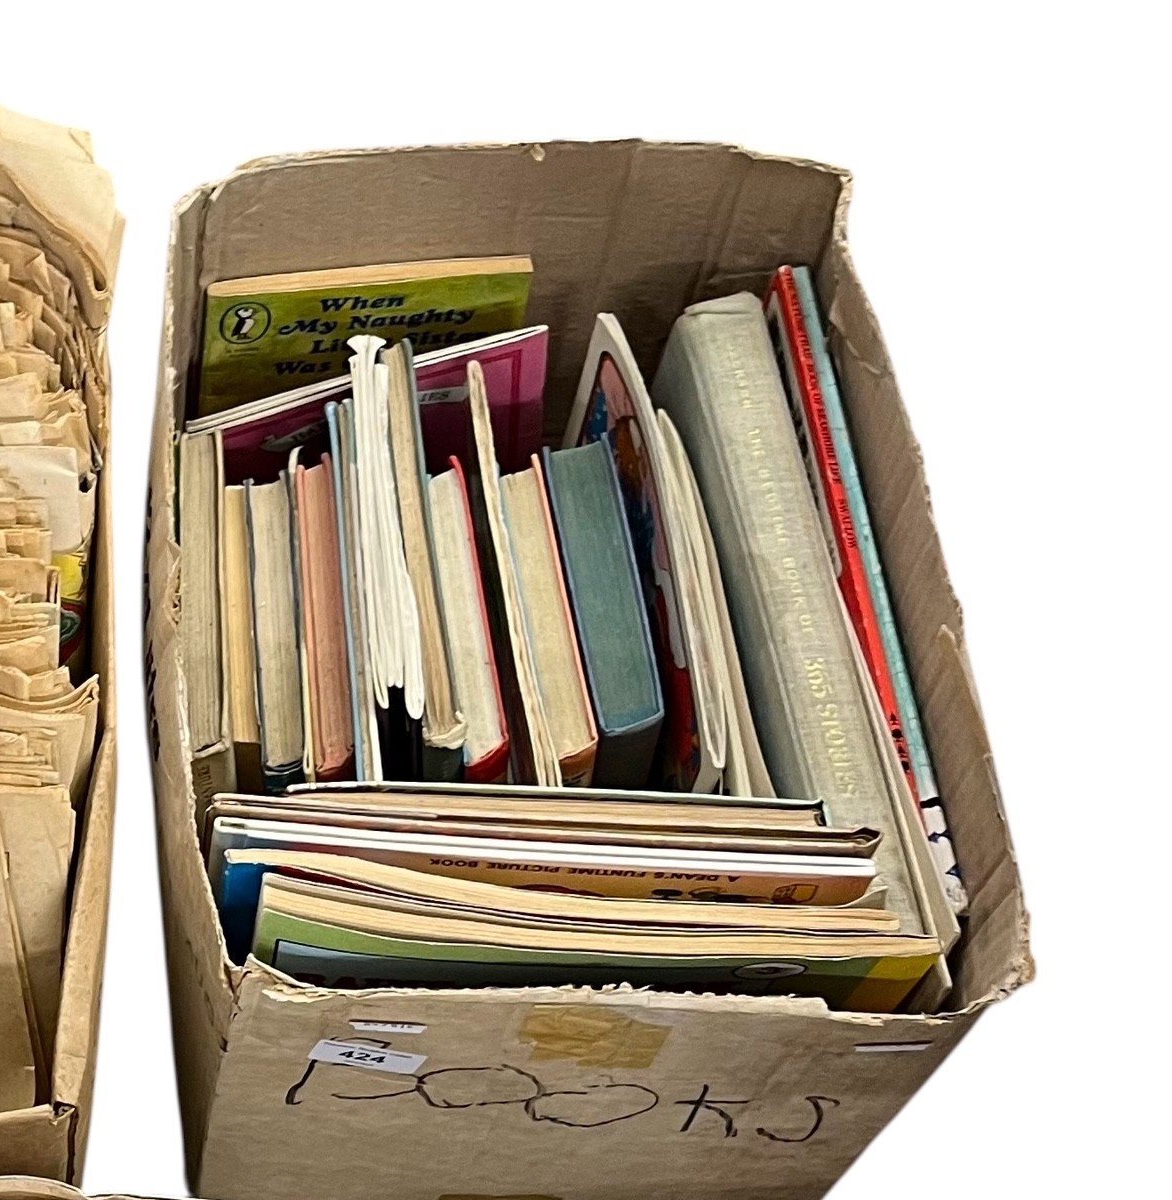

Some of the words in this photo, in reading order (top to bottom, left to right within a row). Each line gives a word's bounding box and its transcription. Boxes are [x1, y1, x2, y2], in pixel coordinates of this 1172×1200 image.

[319, 296, 405, 312] When
[279, 318, 338, 335] My
[347, 308, 476, 329] Naughty
[273, 360, 332, 376] Was
[782, 556, 807, 606] BOOK
[799, 615, 815, 634] OF
[804, 656, 834, 699] 365
[818, 703, 859, 798] STORIES
[428, 857, 479, 869] BOOK
[486, 861, 561, 874] PICTURE
[566, 866, 648, 879] FUNTIME
[654, 871, 720, 883] DEAN'S
[727, 875, 741, 883] A
[338, 1050, 386, 1064] 424
